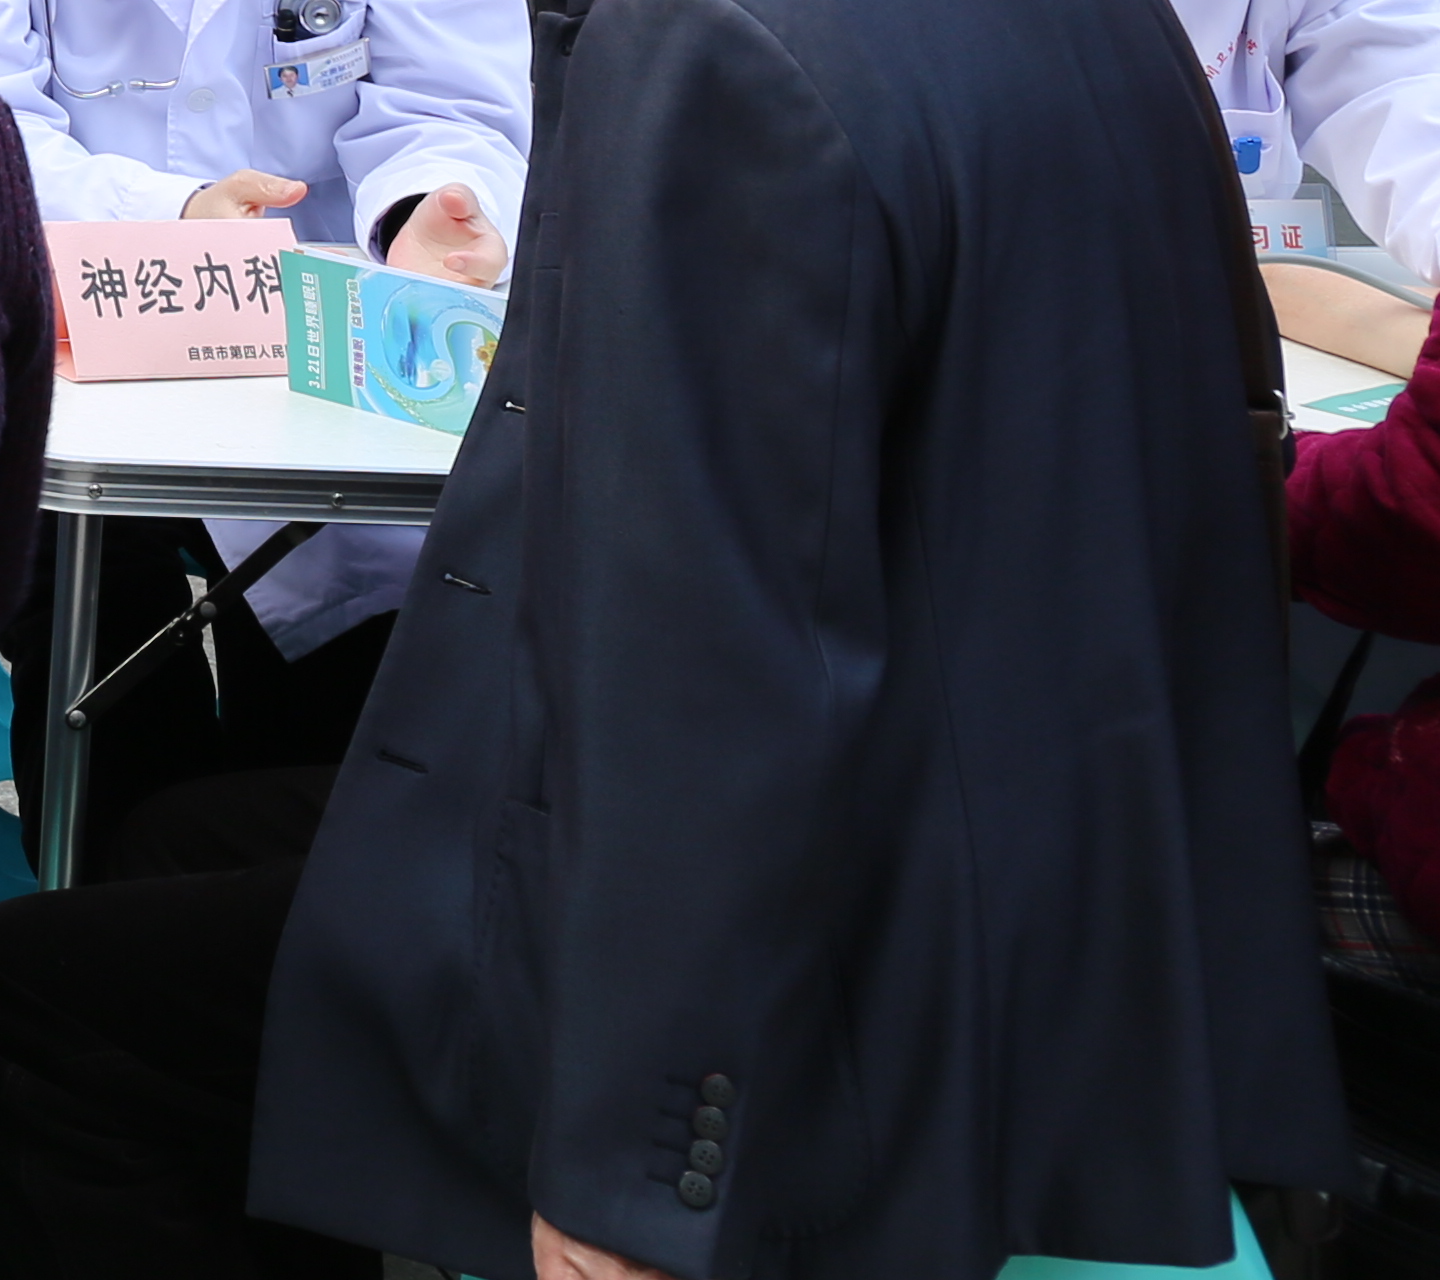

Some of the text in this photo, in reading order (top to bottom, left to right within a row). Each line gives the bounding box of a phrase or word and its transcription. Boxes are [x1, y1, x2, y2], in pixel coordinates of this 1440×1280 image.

[188, 344, 287, 362] 自贡市第四人民
